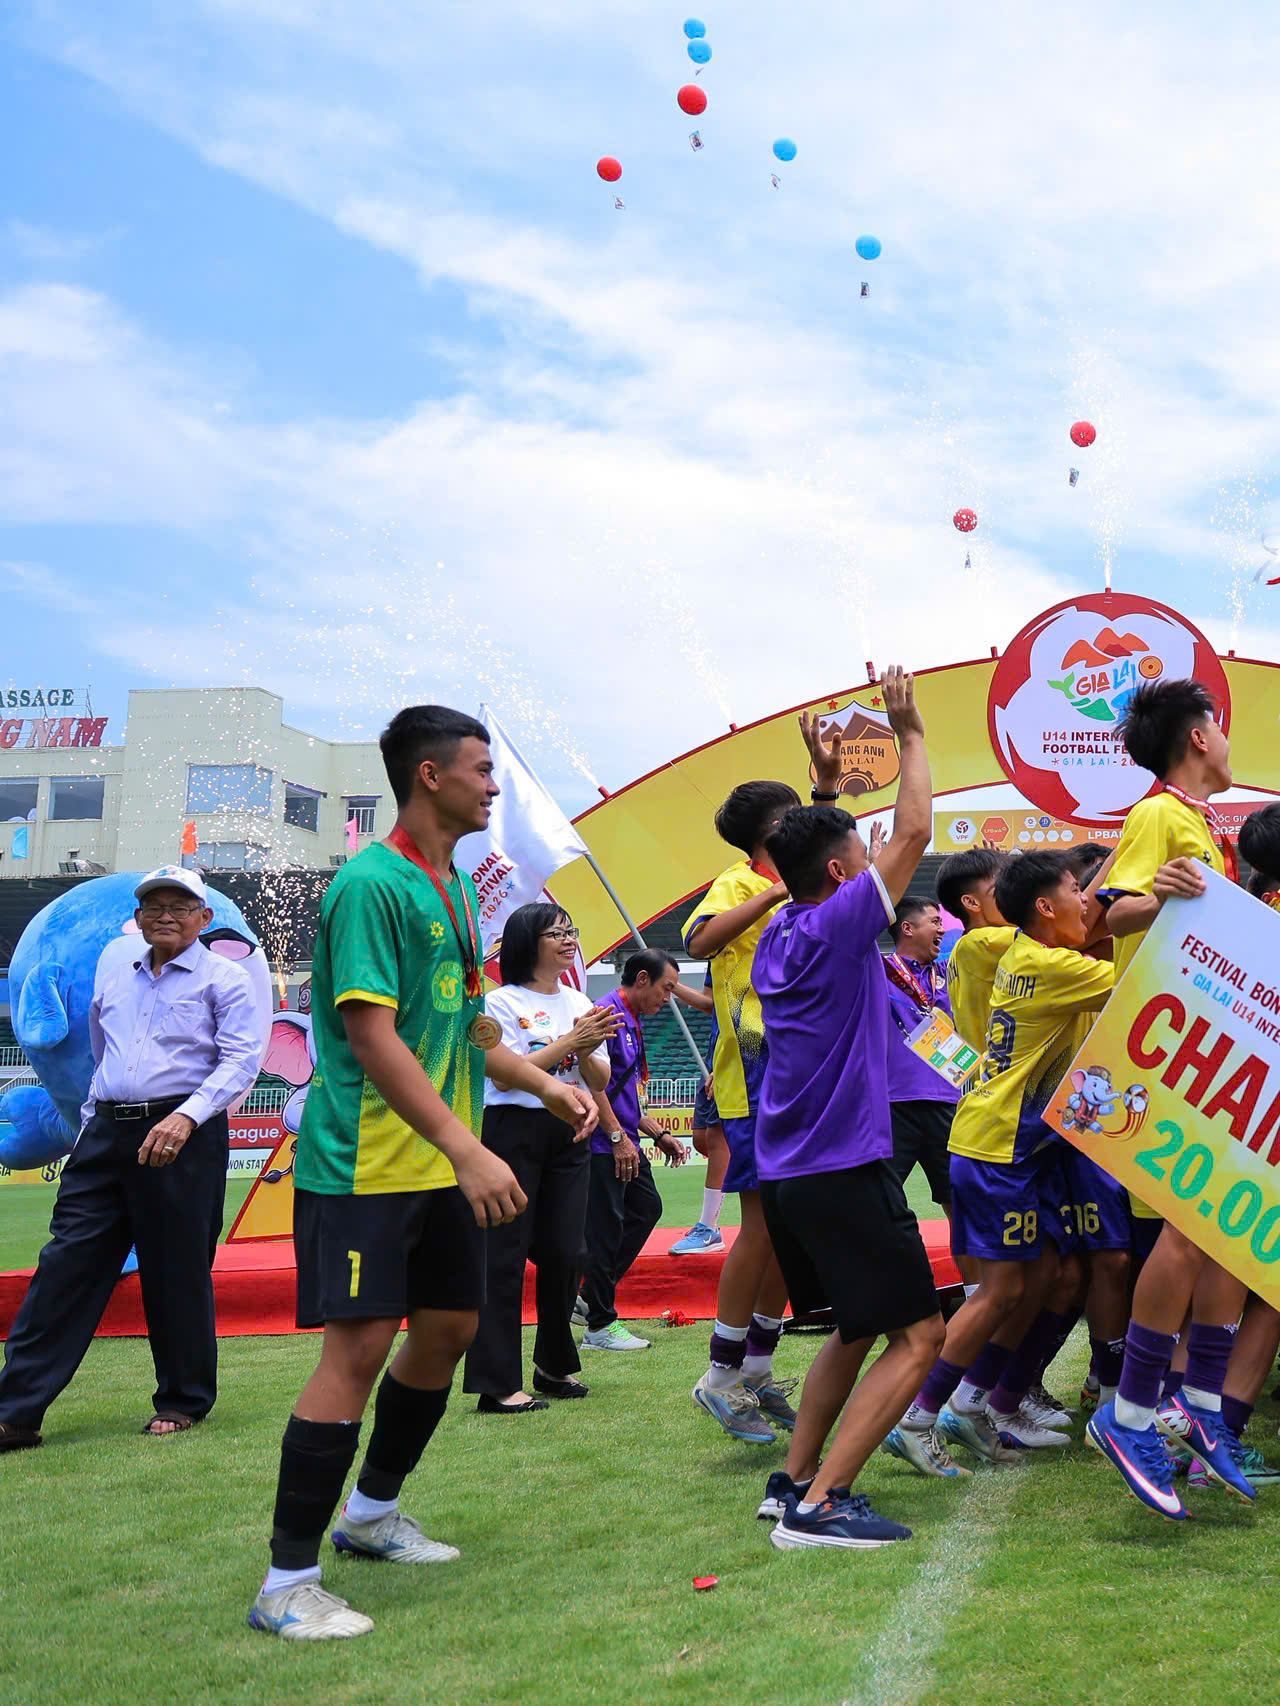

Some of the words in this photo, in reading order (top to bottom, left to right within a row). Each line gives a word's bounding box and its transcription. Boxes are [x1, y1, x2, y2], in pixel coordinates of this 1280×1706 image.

[1076, 672, 1110, 695] GIA
[1113, 660, 1136, 690] LAI
[26, 717, 109, 747] NAM
[1043, 731, 1067, 742] U14
[857, 756, 876, 765] LAI
[863, 745, 885, 758] ANH
[1043, 744, 1109, 754] FOOTBALL
[1063, 757, 1083, 766] GIA
[1091, 757, 1110, 766] LAI
[482, 889, 509, 919] 2026
[1181, 934, 1247, 991] FESTIVAL
[1192, 973, 1211, 993] GIA
[1212, 985, 1233, 1008] LAI
[1232, 999, 1257, 1024] U14
[1003, 1209, 1038, 1246] 28
[1073, 1202, 1100, 1236] 16
[347, 1249, 361, 1298] 1
